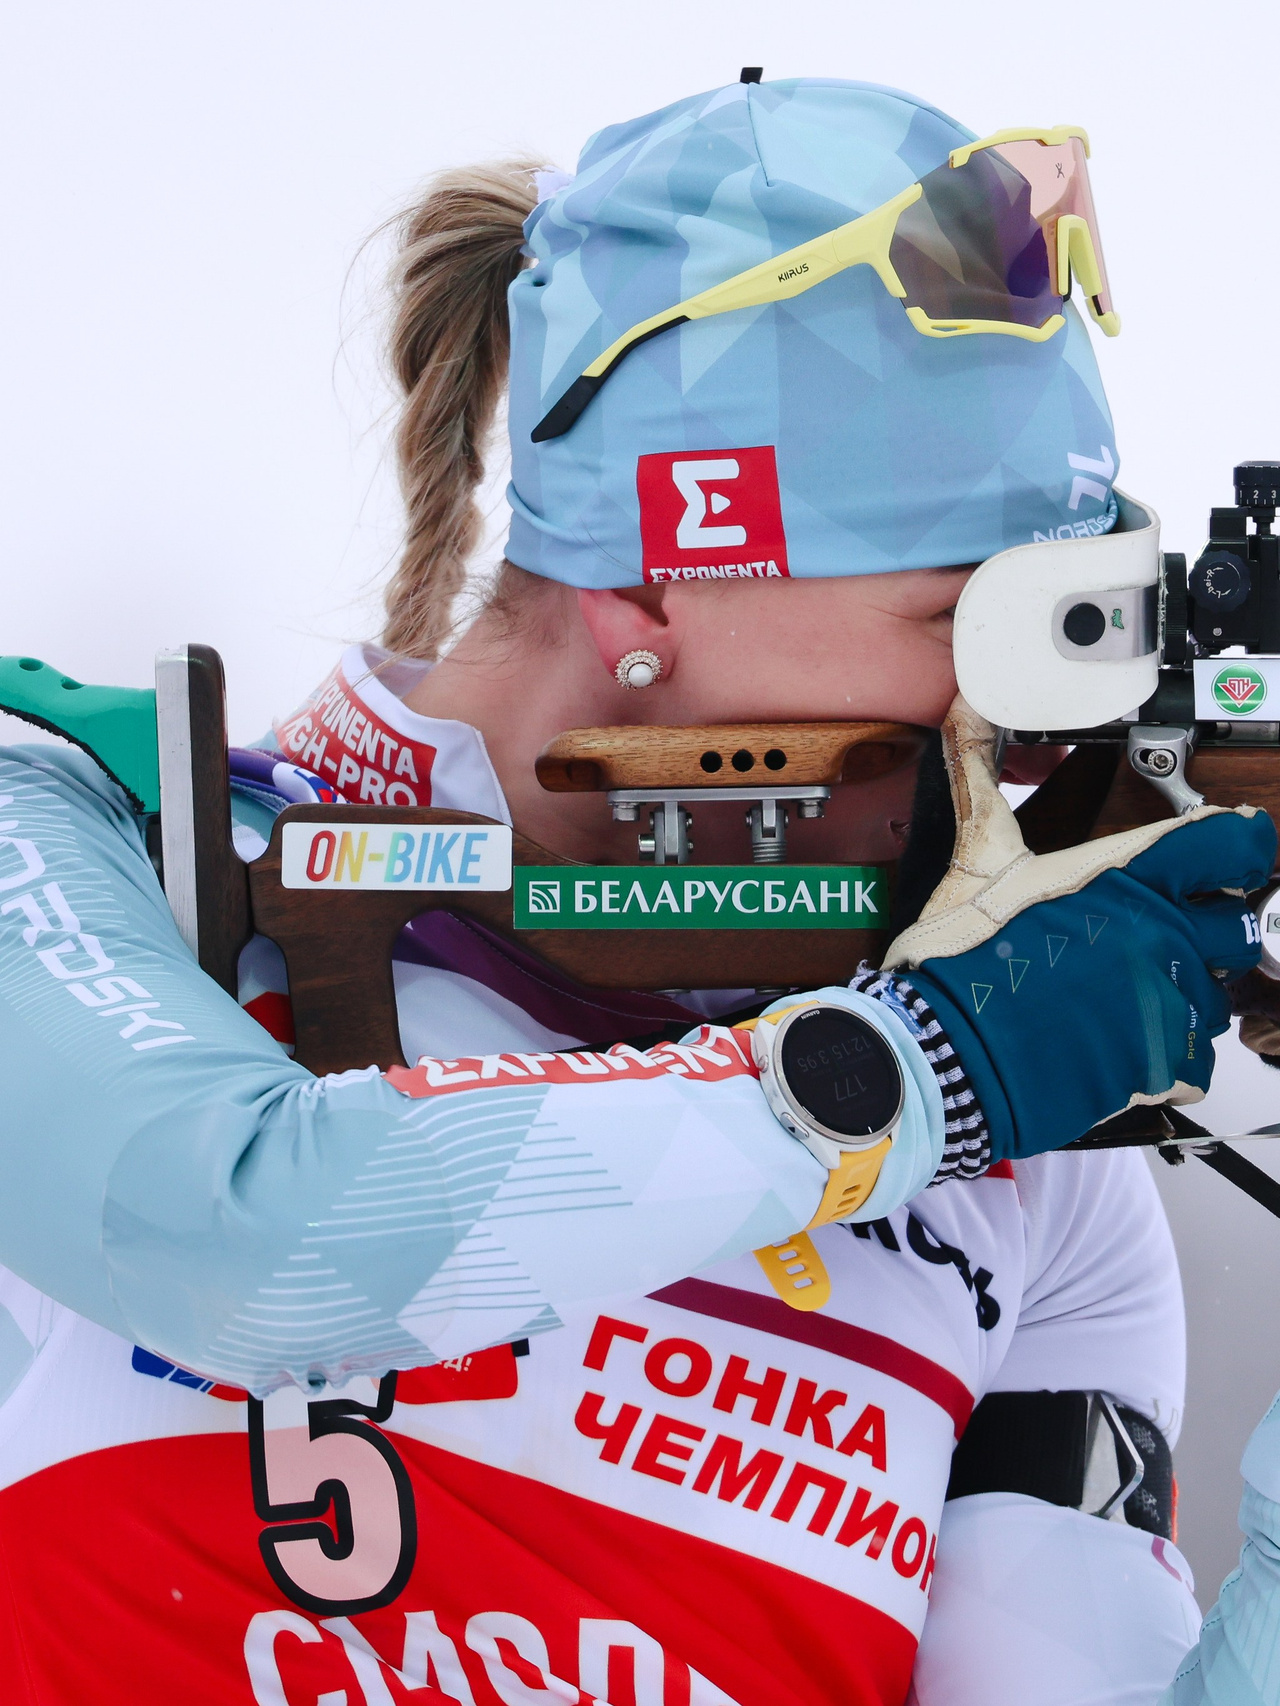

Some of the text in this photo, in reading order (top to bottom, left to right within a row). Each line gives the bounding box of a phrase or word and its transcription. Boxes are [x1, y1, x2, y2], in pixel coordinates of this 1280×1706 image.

[1253, 489, 1259, 499] 2
[1271, 489, 1277, 499] 3
[305, 830, 489, 883] ON-BIKE
[574, 879, 879, 914] БЕЛАРУСБАНК
[582, 1315, 887, 1473] ГОНКА
[248, 1385, 417, 1616] 5
